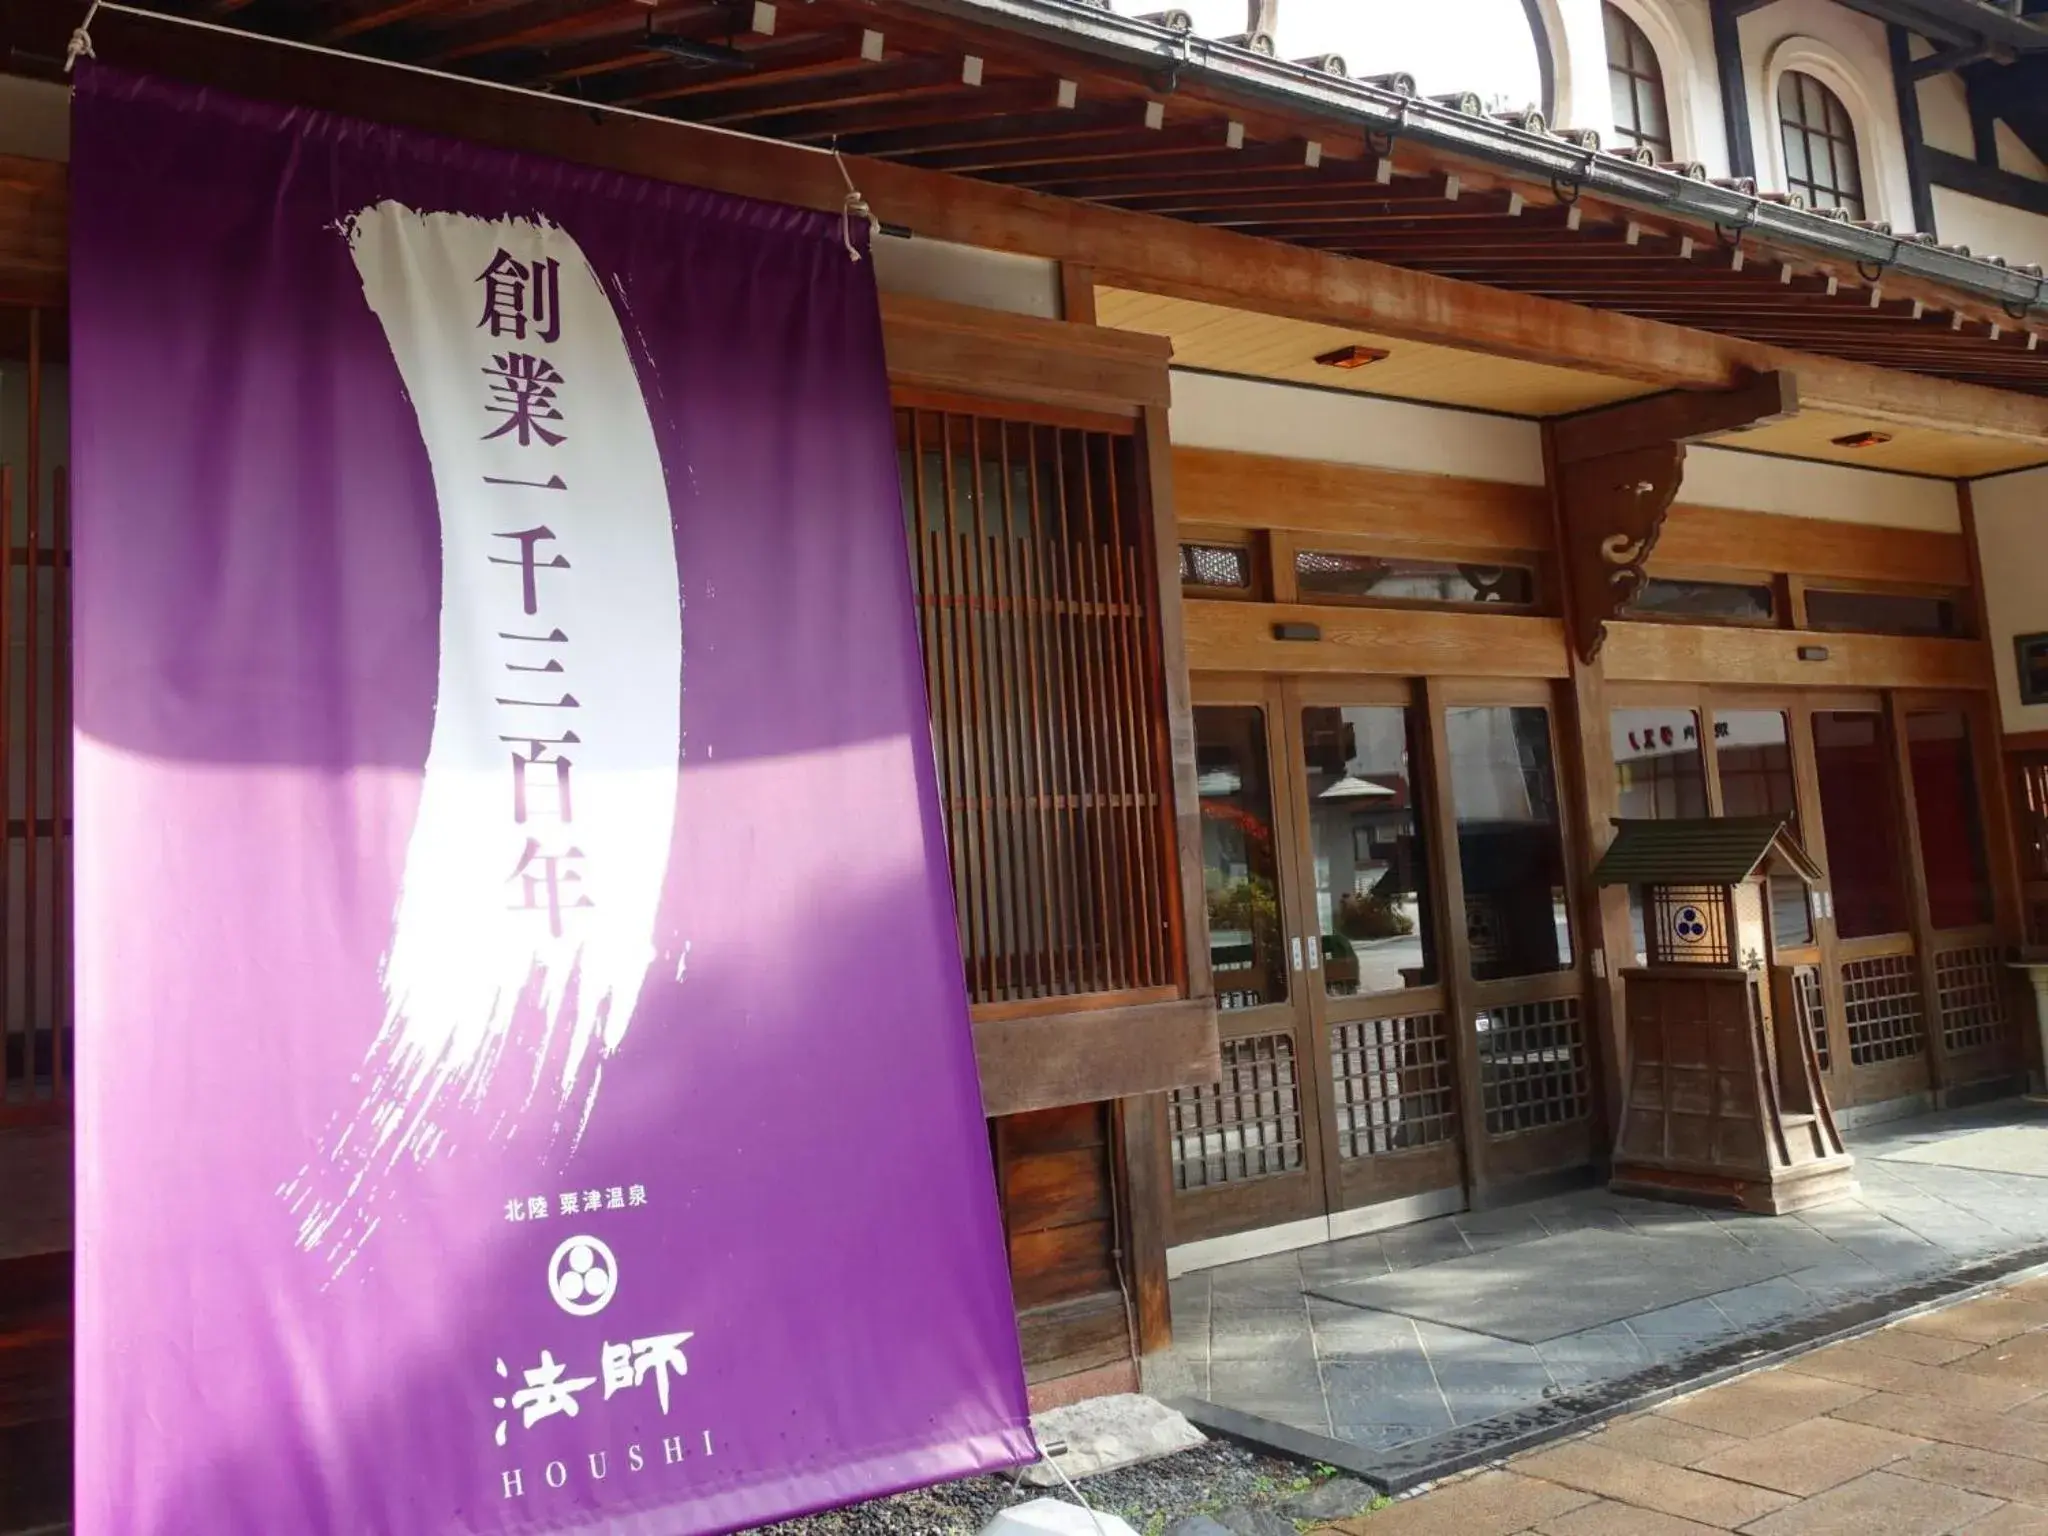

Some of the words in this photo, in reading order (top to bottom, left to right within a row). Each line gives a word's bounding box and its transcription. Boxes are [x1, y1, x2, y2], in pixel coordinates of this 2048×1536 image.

[474, 247, 595, 939] 創業一千三百年
[504, 1196, 549, 1222] 北陸
[559, 1184, 648, 1215] 粟津温泉
[493, 1331, 695, 1447] 法師
[502, 1430, 714, 1499] HOUSHI
